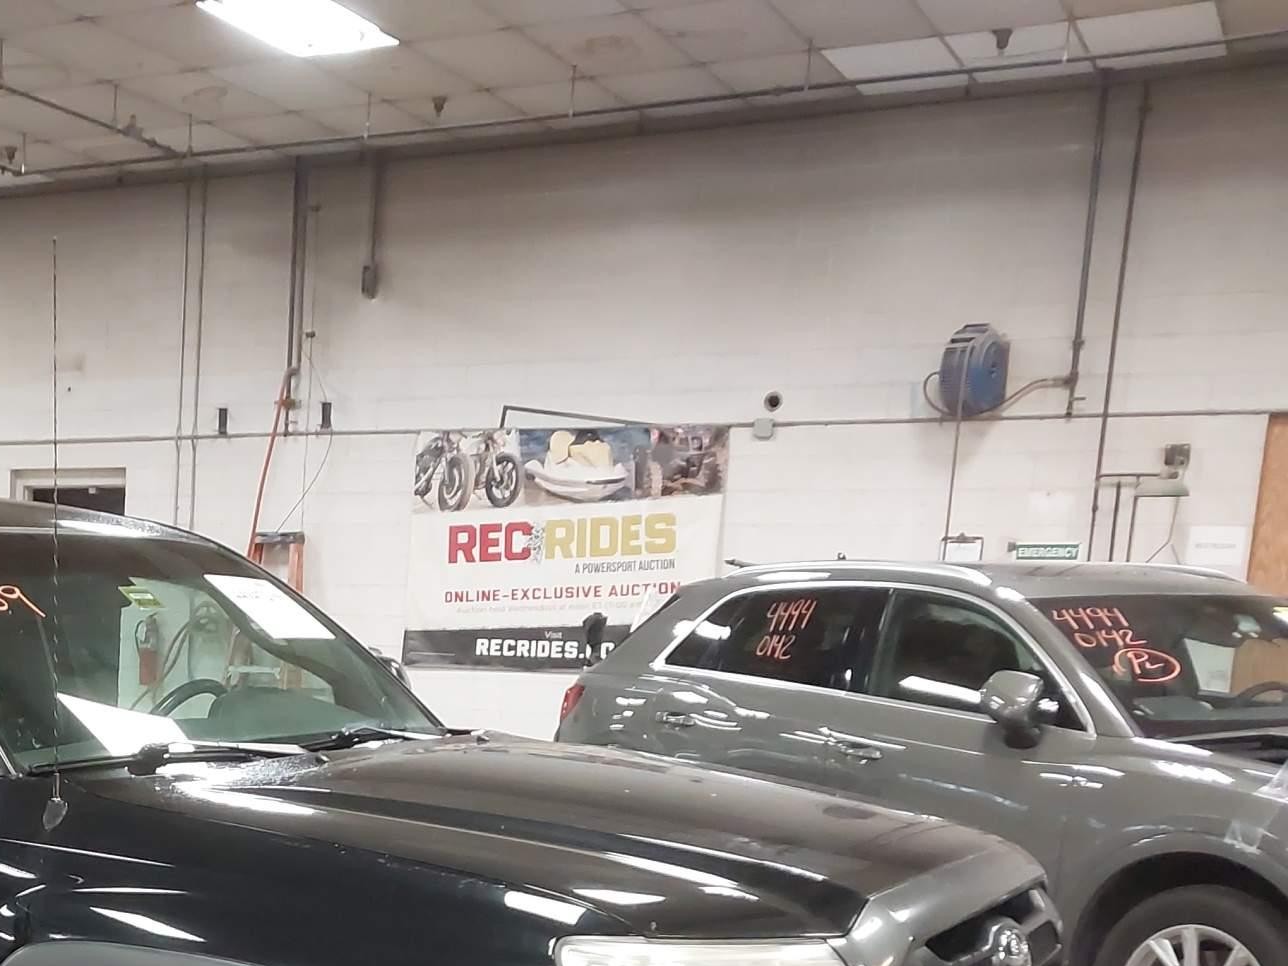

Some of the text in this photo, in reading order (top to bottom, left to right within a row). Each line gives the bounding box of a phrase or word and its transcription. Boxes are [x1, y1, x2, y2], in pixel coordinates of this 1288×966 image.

[448, 513, 676, 563] REC RIDES
[1017, 547, 1078, 558] EMERGENCY
[575, 558, 675, 574] A POWERSPORT AUCTION
[444, 584, 601, 603] ONLINE-EXCLUSIVE
[767, 599, 817, 632] 4494
[1052, 607, 1129, 629] 4494
[756, 634, 796, 659] 0142
[1074, 629, 1148, 648] 0142
